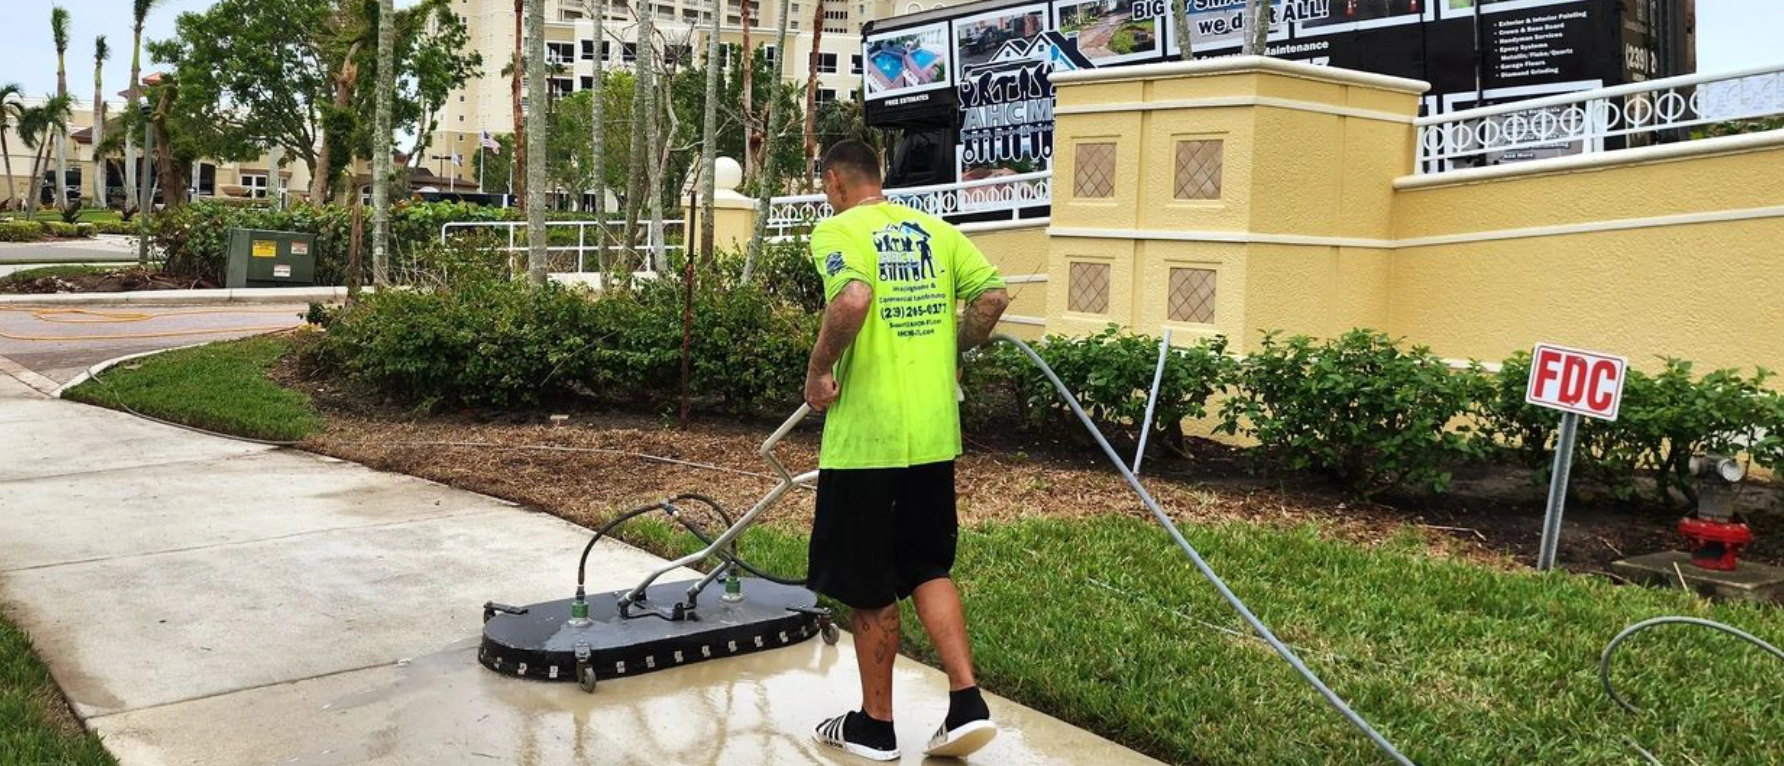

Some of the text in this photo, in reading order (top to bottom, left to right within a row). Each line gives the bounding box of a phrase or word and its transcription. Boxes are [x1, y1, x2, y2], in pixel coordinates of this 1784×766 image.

[1133, 0, 1166, 19] BIG
[1198, 18, 1226, 34] we
[1282, 0, 1329, 21] ALL!
[962, 98, 1053, 131] AHCM
[1534, 350, 1617, 412] FDC
